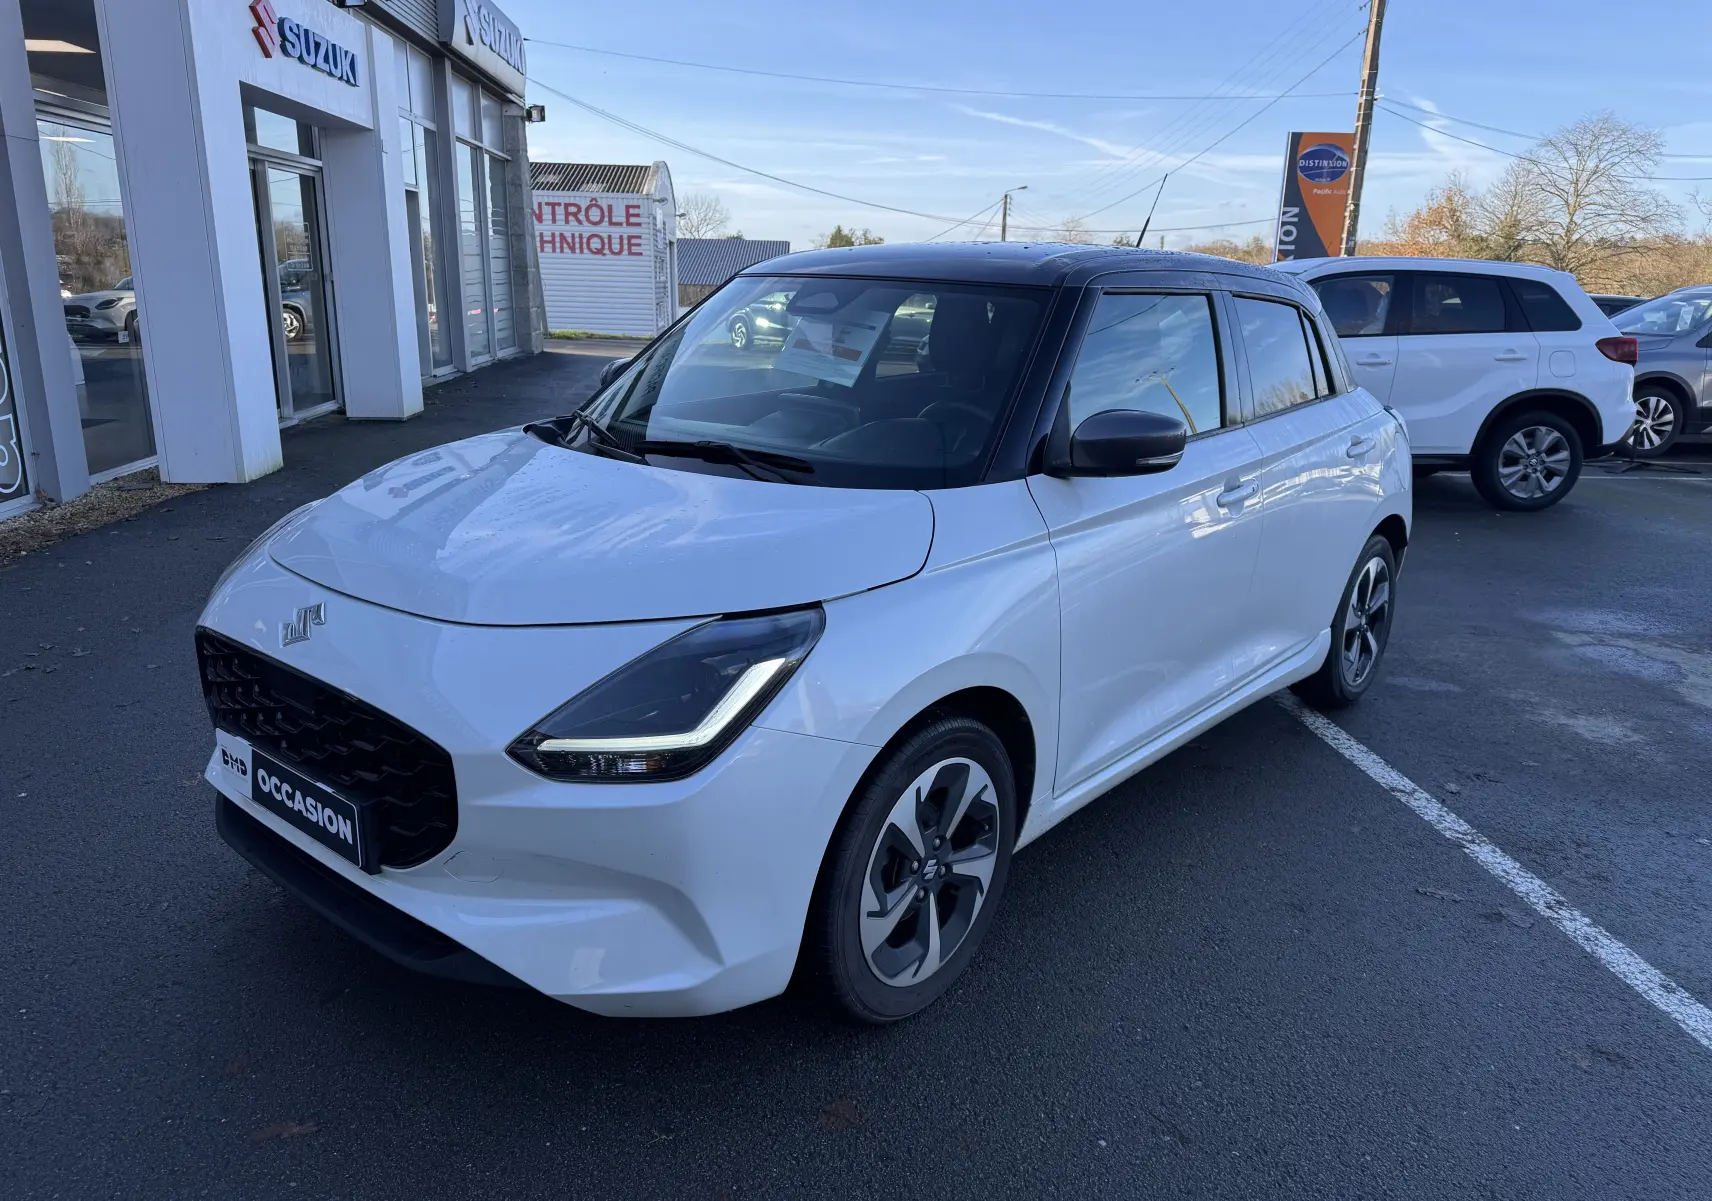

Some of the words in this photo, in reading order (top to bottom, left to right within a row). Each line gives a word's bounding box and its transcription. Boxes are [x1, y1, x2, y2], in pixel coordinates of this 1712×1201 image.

[278, 17, 360, 87] SUZUKI
[478, 5, 525, 76] SUZUKI
[1299, 159, 1348, 168] DISTINXION
[539, 232, 644, 257] HNIQUE
[257, 768, 353, 845] OCCASION
